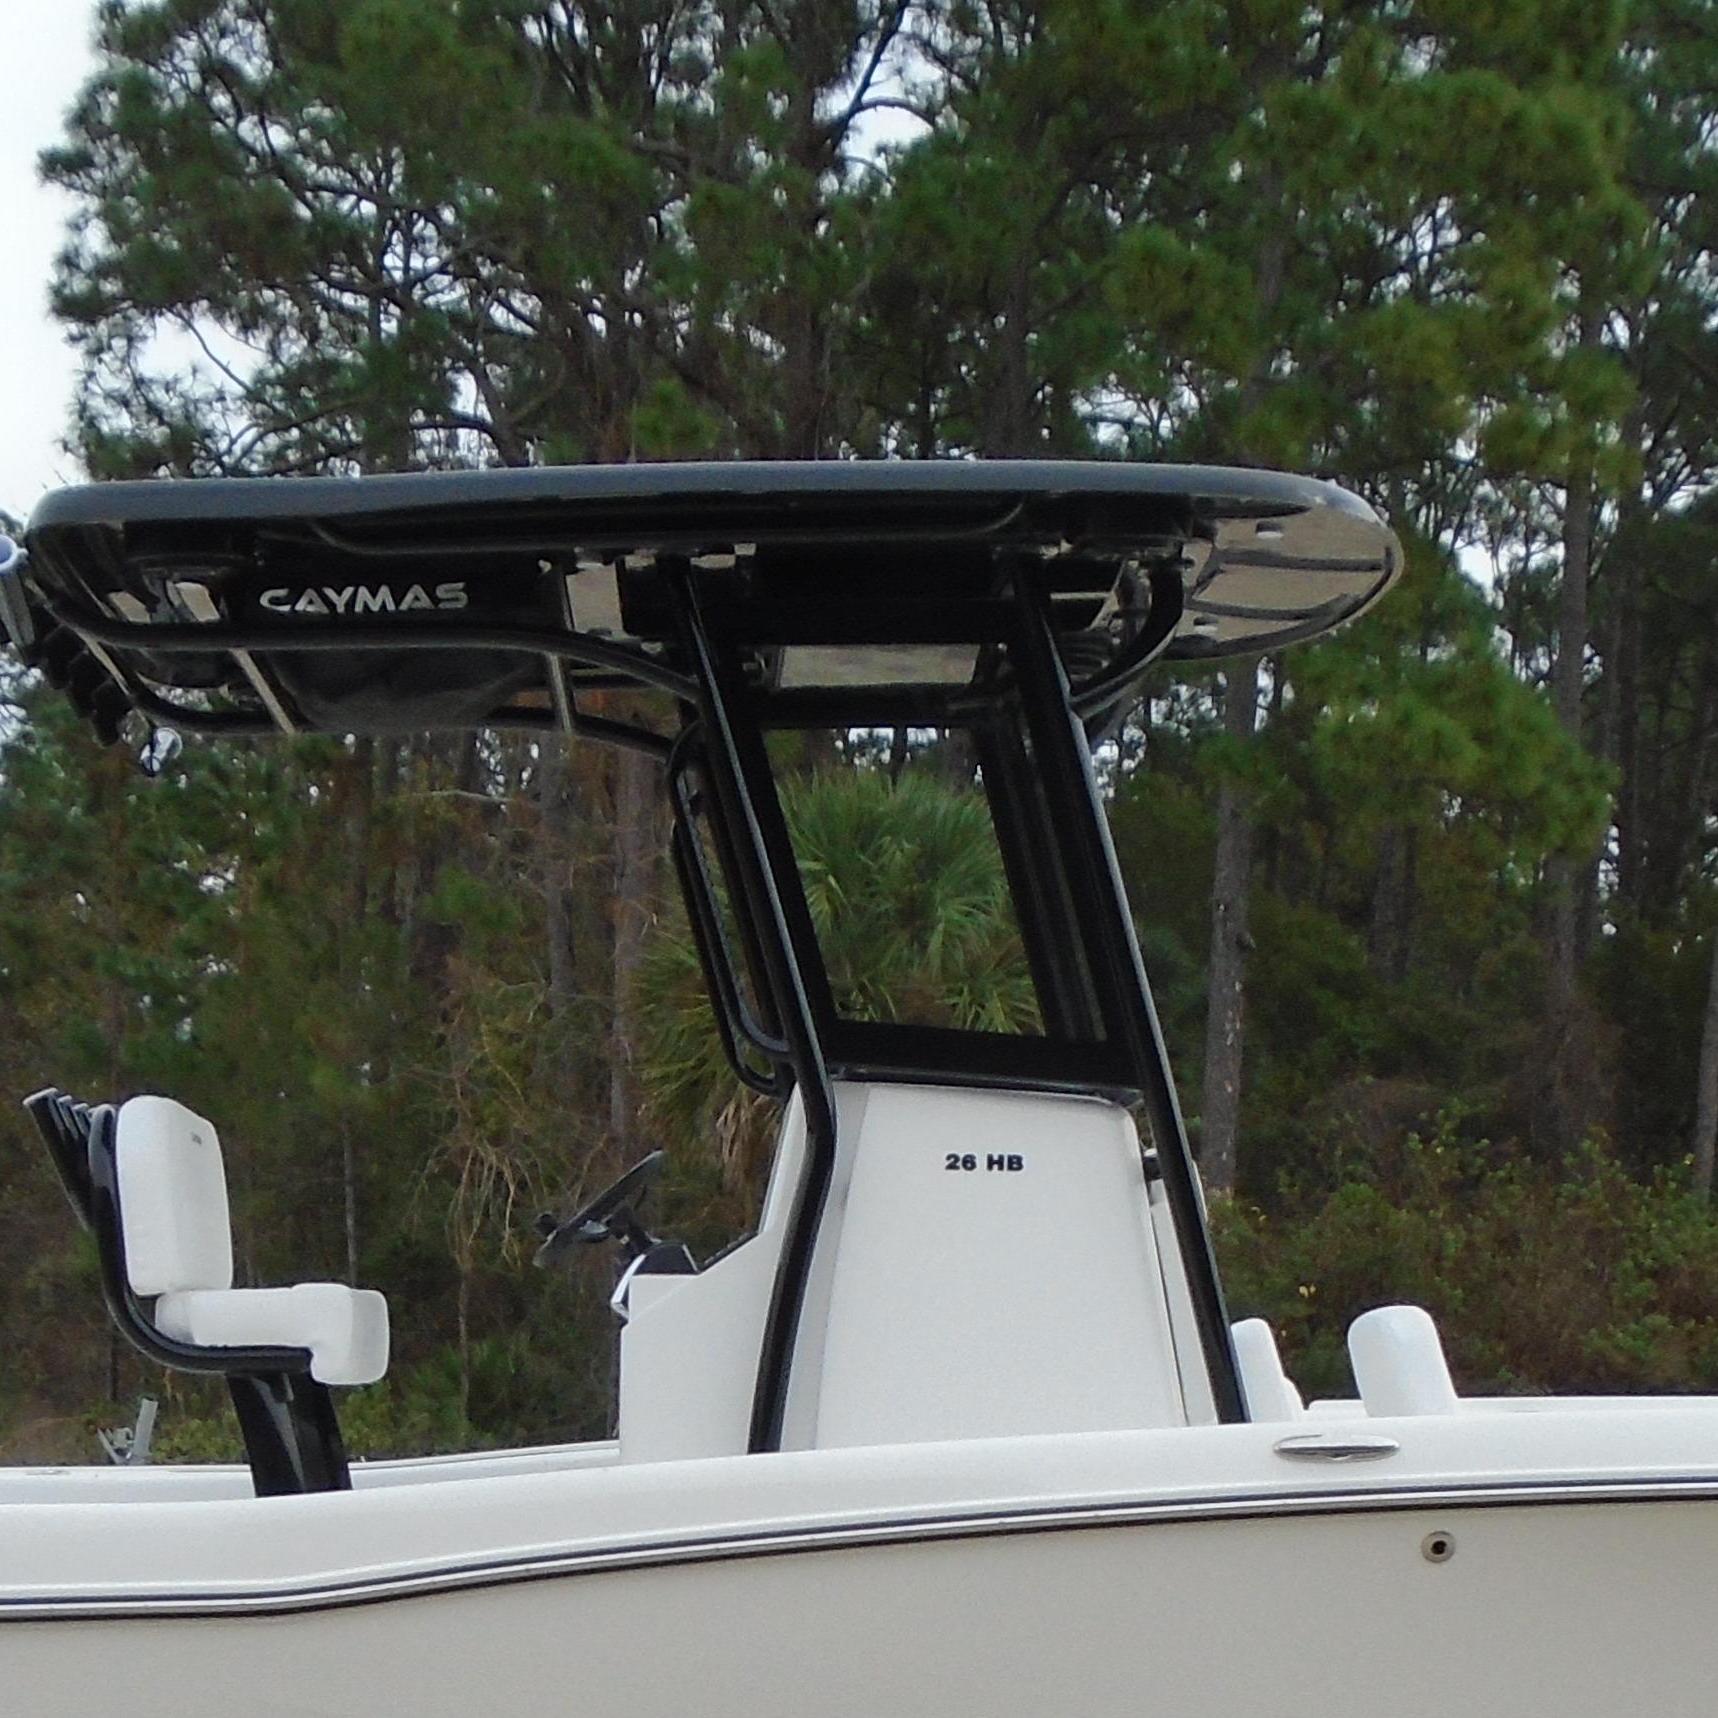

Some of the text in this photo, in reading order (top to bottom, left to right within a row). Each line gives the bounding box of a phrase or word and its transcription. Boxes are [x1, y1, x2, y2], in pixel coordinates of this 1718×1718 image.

[259, 581, 469, 614] CAYMAS
[945, 1153, 1024, 1171] 26 HB
